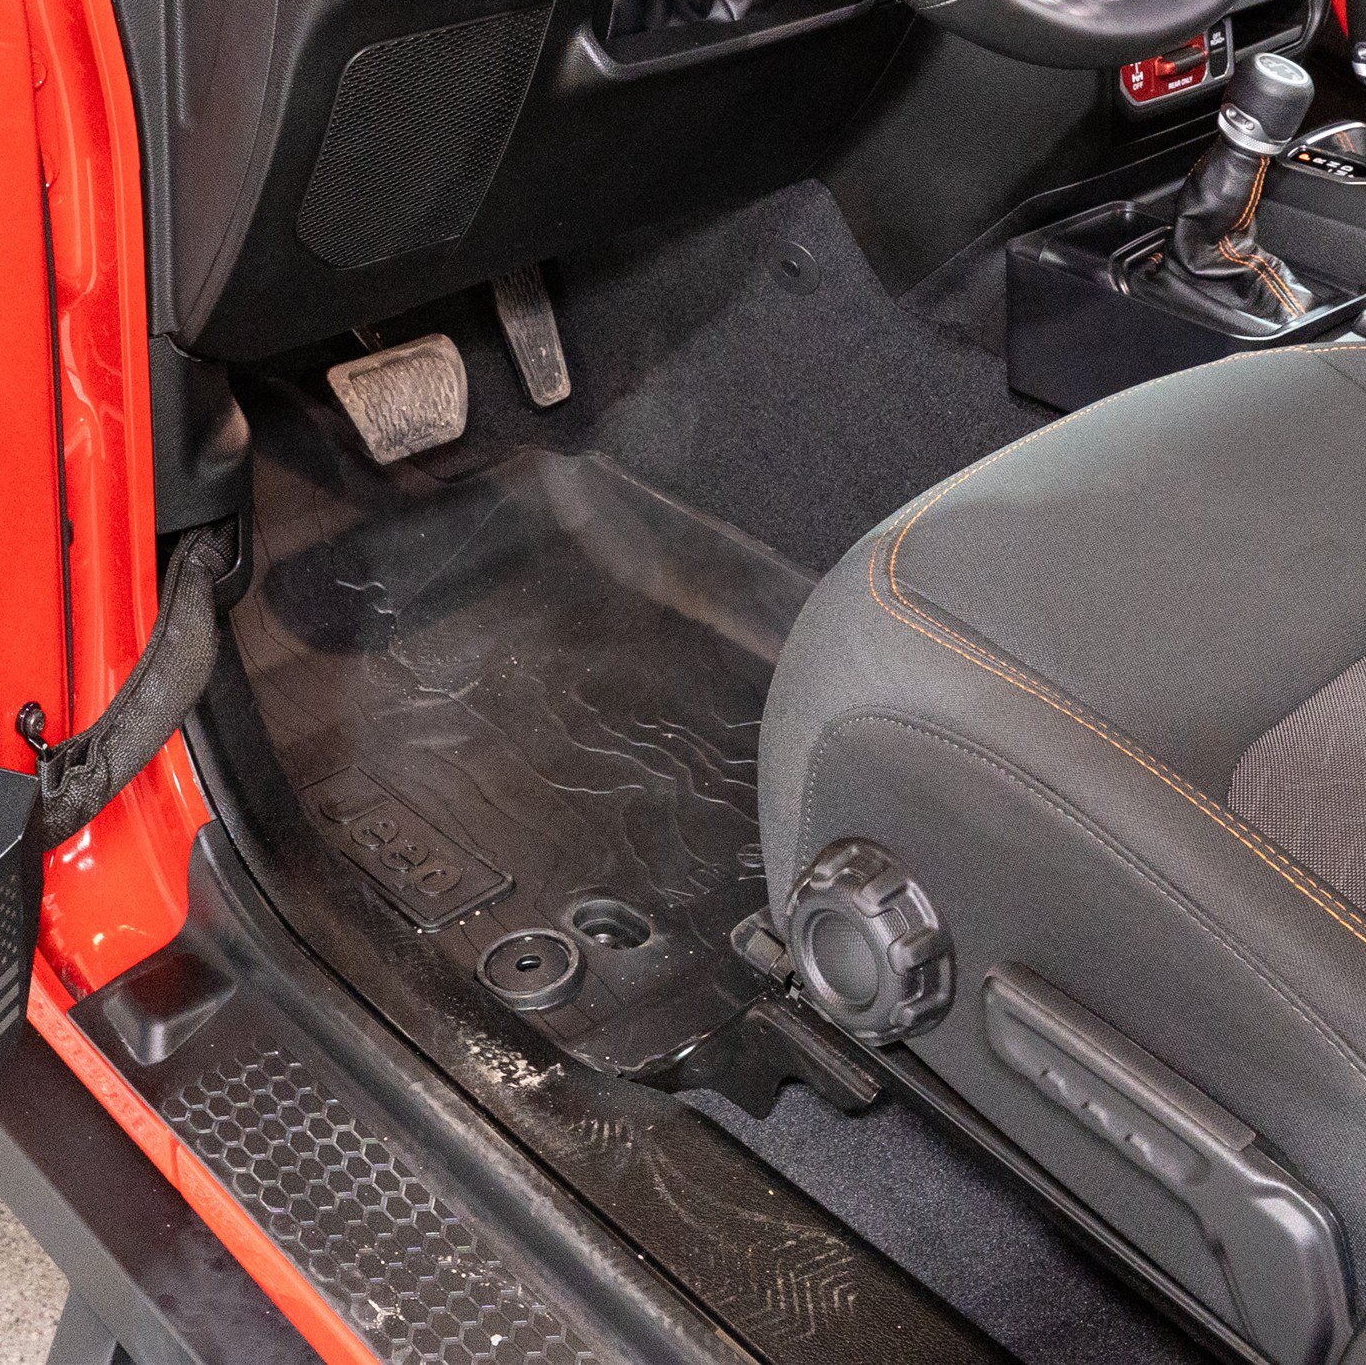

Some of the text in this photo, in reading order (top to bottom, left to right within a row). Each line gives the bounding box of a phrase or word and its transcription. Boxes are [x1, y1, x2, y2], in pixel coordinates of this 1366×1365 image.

[1298, 153, 1311, 161] P
[1312, 157, 1327, 165] R
[1340, 165, 1354, 173] D
[319, 795, 463, 898] Jeep
